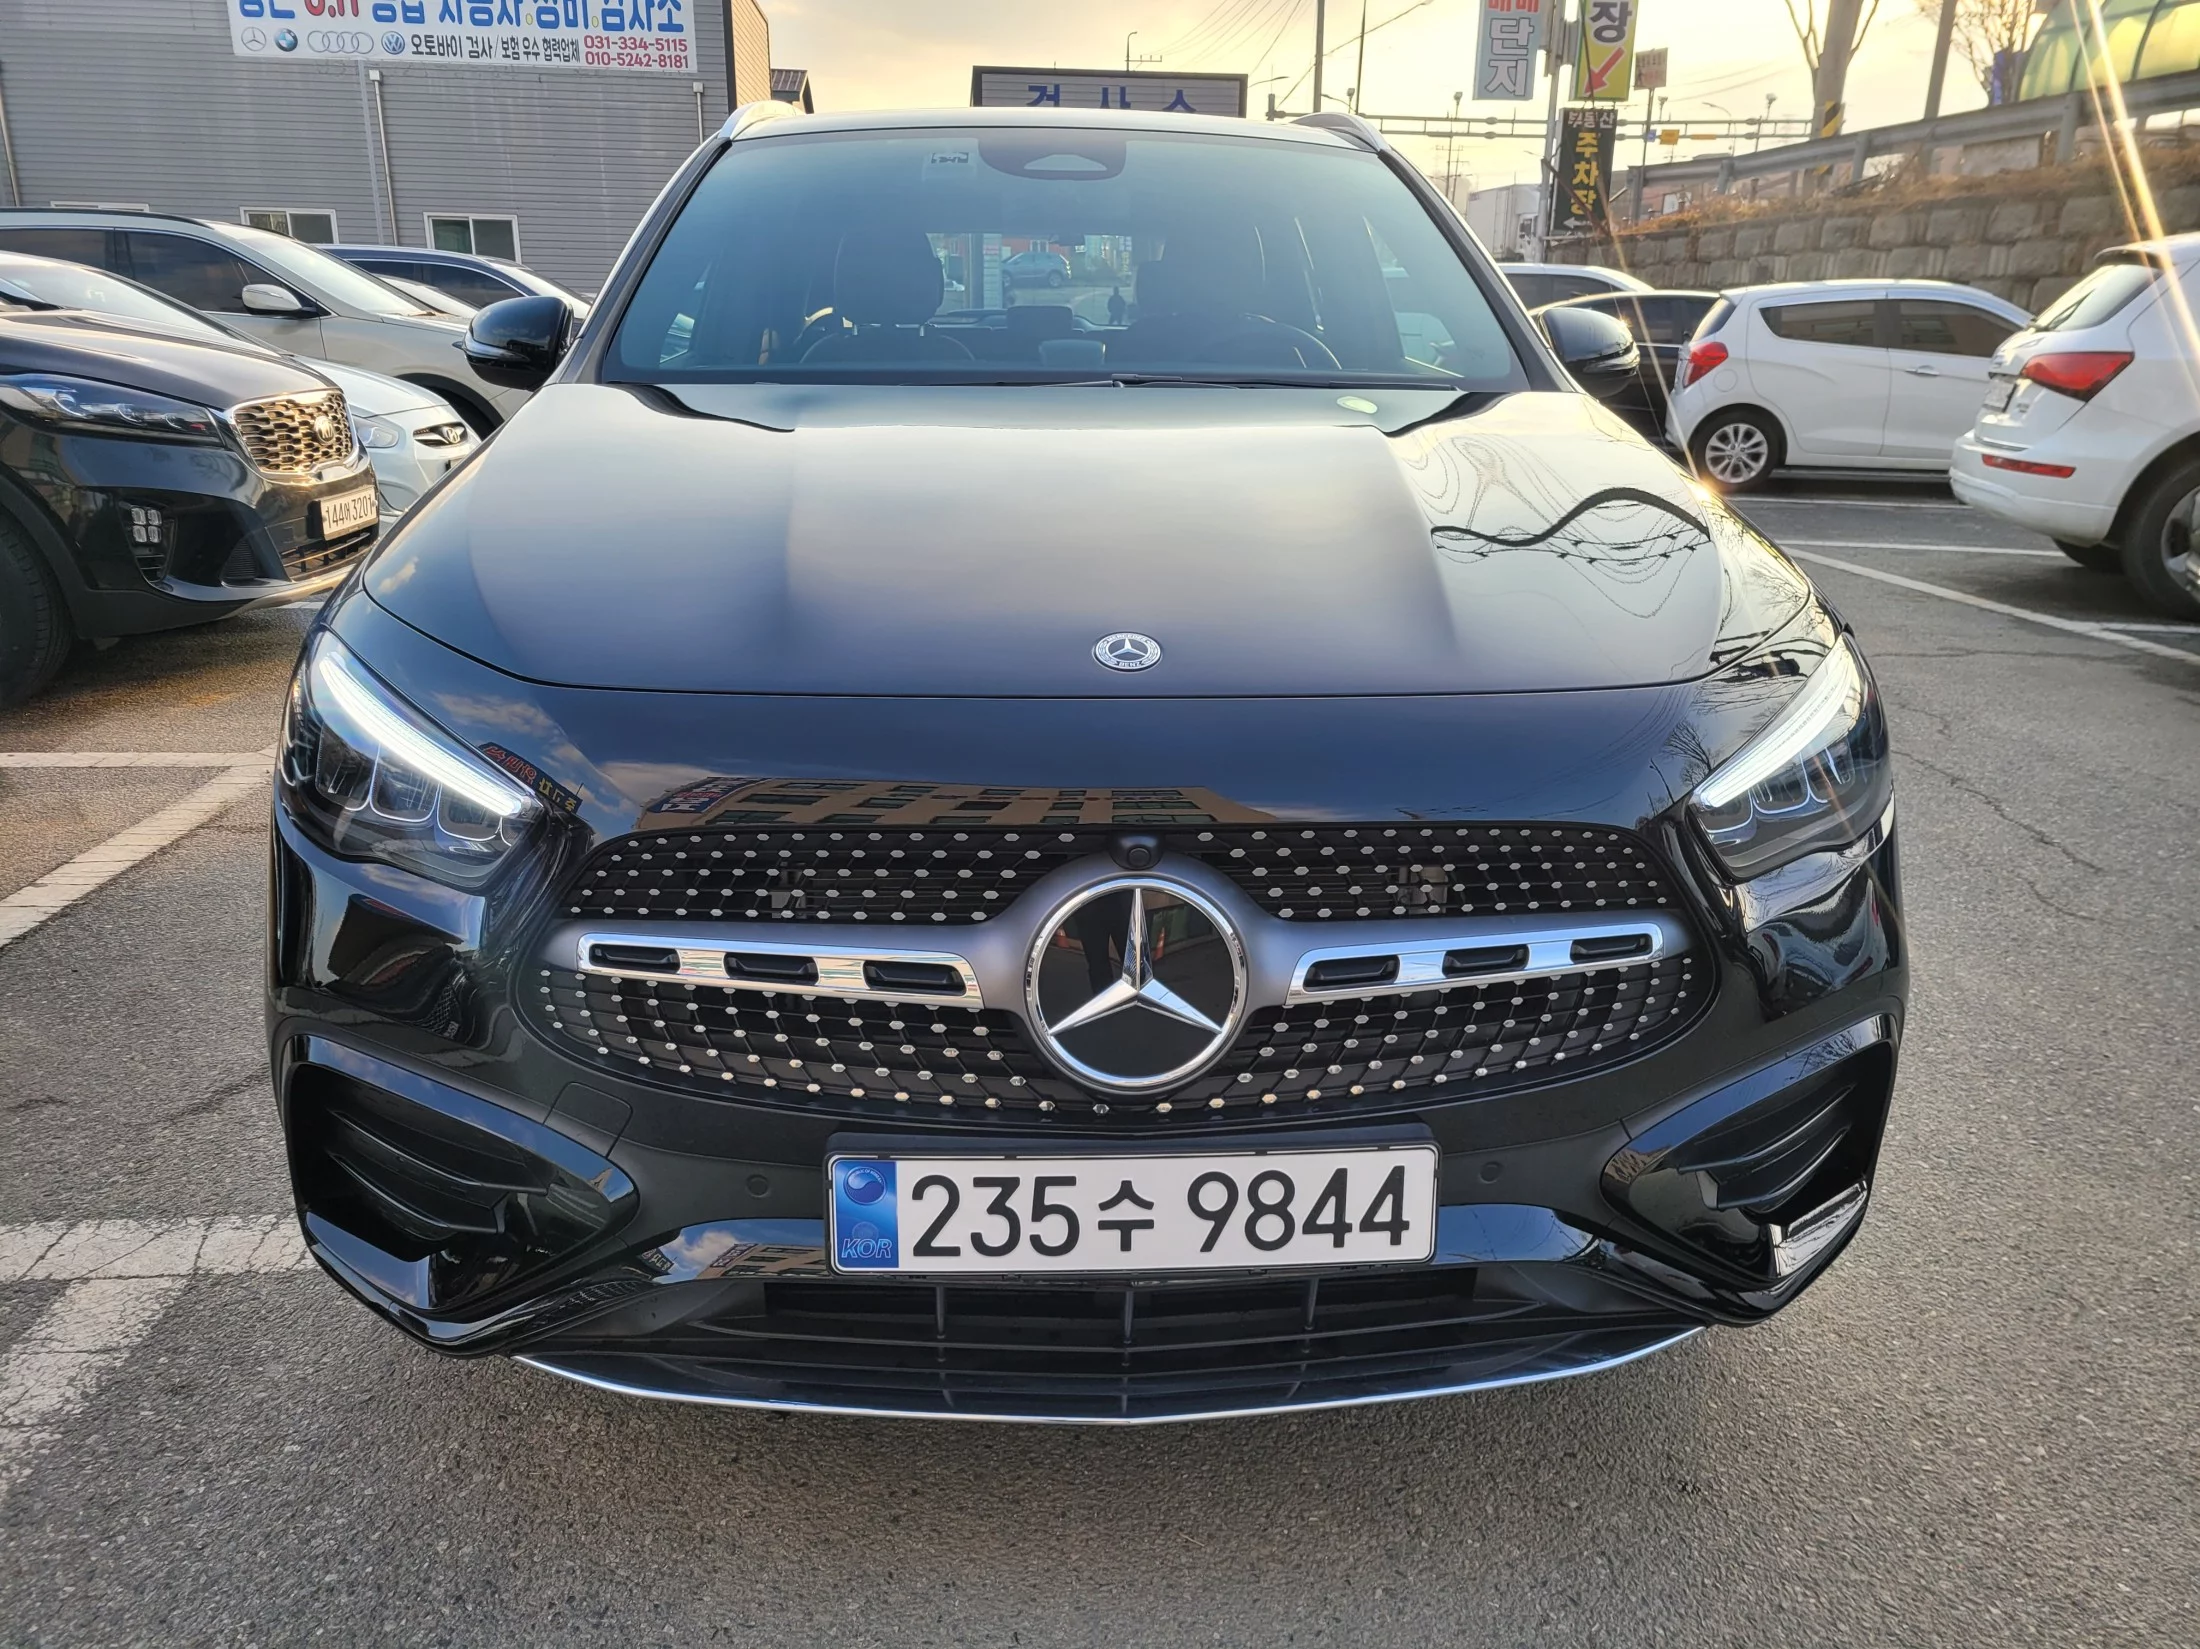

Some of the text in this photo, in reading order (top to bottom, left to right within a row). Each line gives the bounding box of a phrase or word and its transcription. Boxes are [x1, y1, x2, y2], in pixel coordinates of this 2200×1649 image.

[411, 34, 463, 58] 오토바이
[522, 36, 541, 61] 우수
[542, 36, 581, 63] 협력업체
[583, 34, 688, 53] 031-334-5115
[585, 51, 689, 69] 010-5242-8181
[1570, 132, 1600, 215] 주차장
[351, 493, 373, 521] 3201
[911, 1164, 1411, 1258] 235수 9844
[841, 1238, 893, 1259] KOR
